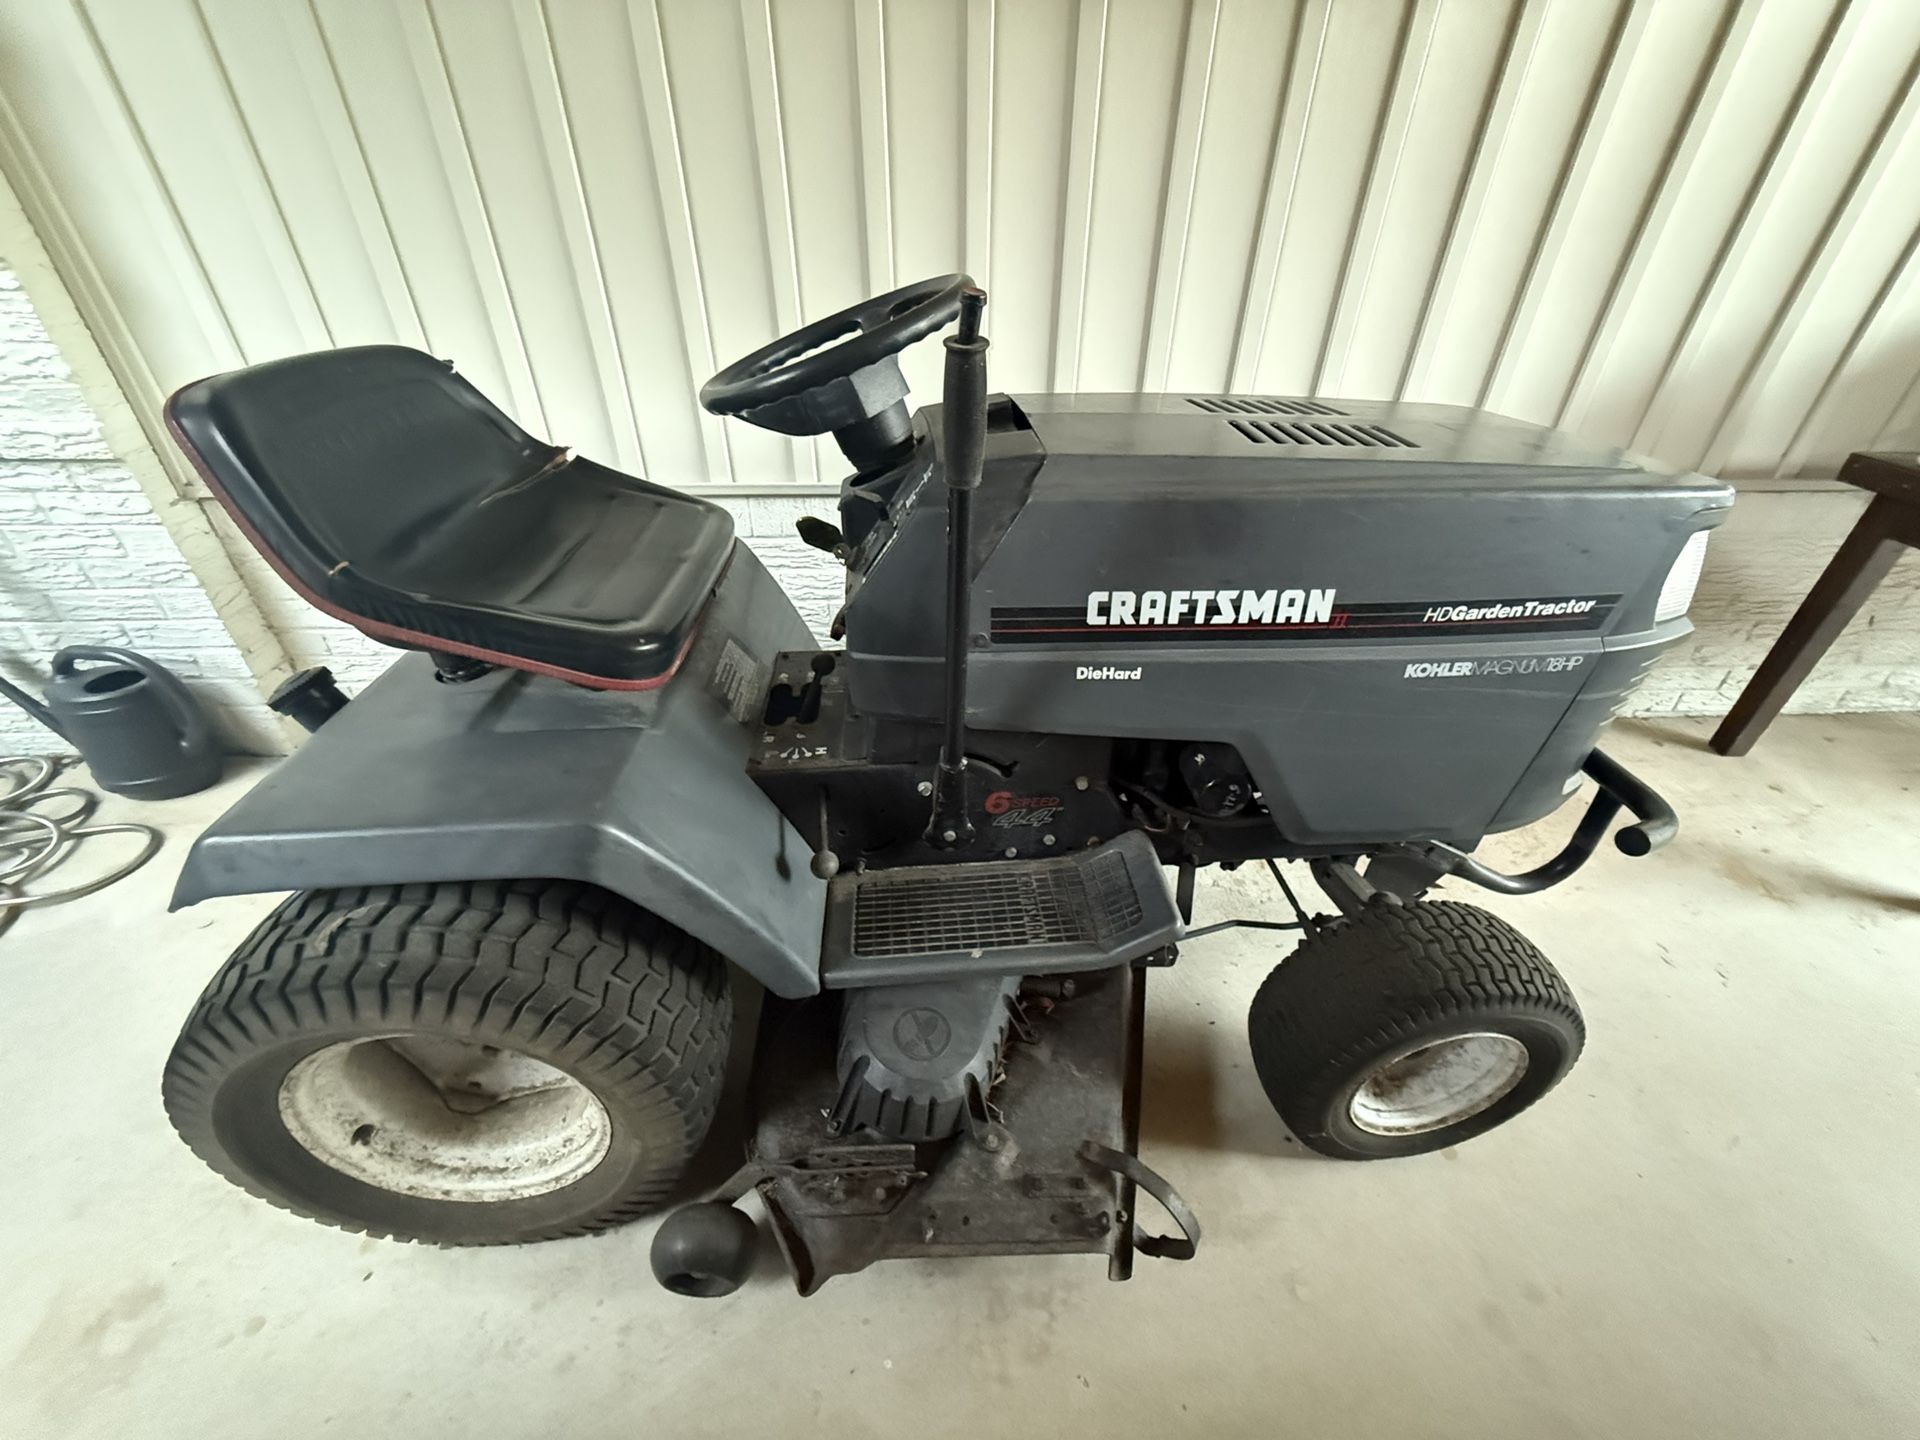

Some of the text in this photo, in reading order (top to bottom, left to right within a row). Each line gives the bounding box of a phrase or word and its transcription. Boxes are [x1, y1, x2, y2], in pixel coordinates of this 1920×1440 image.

[1086, 588, 1337, 626] CRAFTSMAN
[1075, 666, 1143, 681] DieHard
[985, 791, 1014, 814] 6
